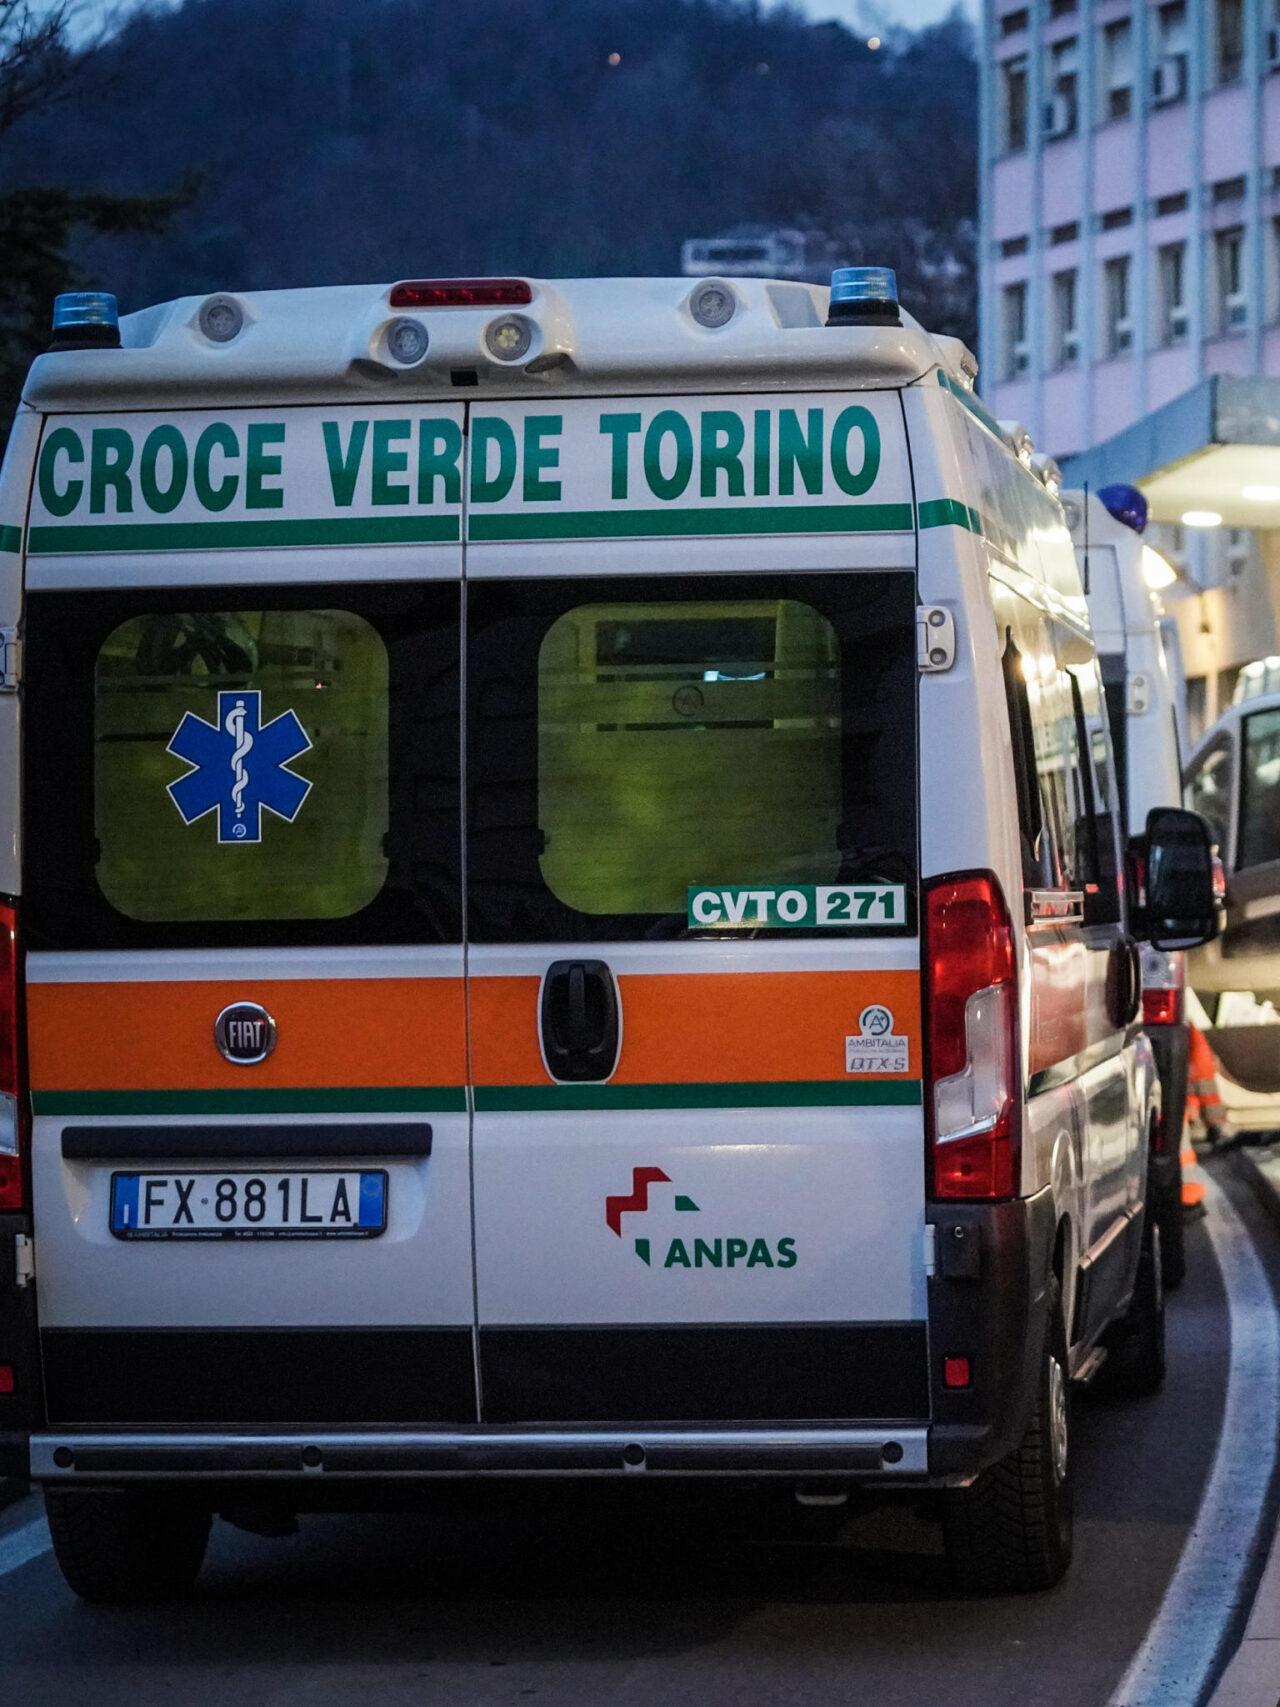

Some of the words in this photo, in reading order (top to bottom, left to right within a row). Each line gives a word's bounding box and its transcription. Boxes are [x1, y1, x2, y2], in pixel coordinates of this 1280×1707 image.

[38, 421, 286, 517] CROCE
[322, 414, 563, 508] VERDE
[598, 405, 881, 500] TORINO
[691, 889, 808, 923] CVTO
[826, 891, 895, 919] 271
[229, 1021, 265, 1048] FIAT
[848, 1038, 906, 1048] AMBITALIA
[663, 1237, 798, 1268] ANPAS
